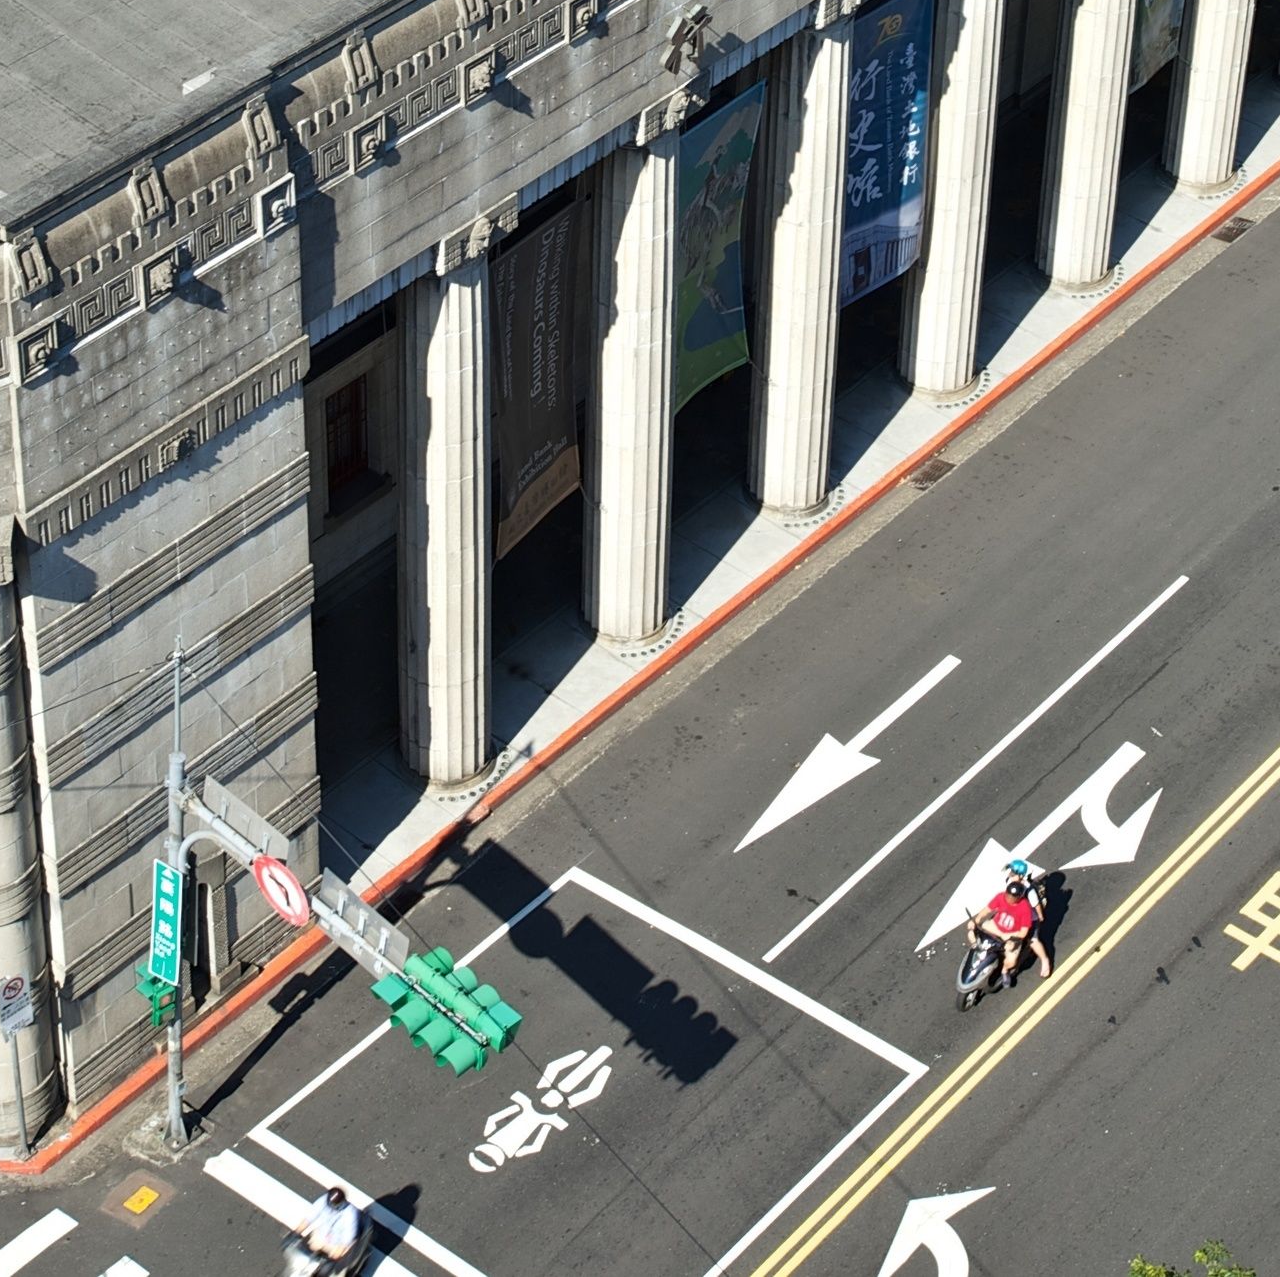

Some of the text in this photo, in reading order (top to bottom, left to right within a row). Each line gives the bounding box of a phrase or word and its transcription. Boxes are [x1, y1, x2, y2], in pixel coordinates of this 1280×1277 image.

[899, 42, 921, 186] 臺灣土地銀行
[533, 226, 556, 322] Dinosaurs
[548, 280, 561, 331] within
[530, 321, 546, 398] Coming
[546, 330, 560, 411] Skeletons:
